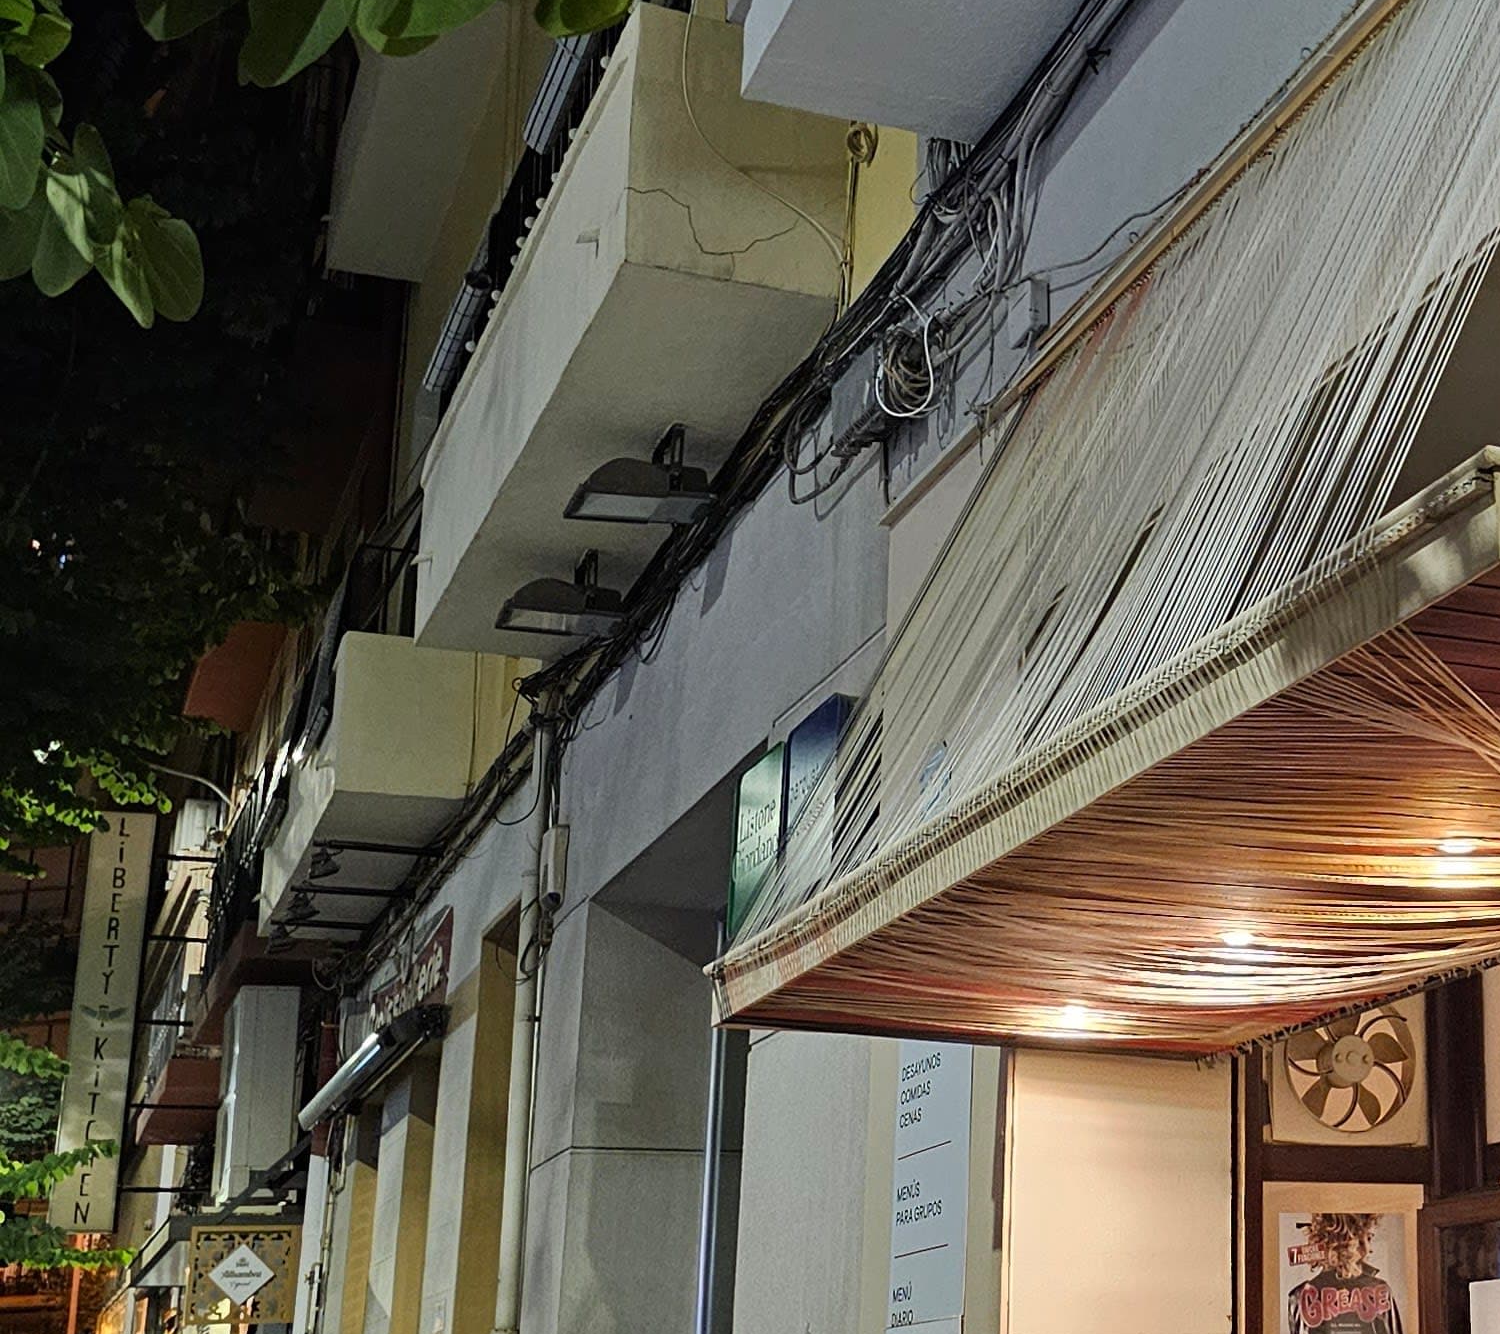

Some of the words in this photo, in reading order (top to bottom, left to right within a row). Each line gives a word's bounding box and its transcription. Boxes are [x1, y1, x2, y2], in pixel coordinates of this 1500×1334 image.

[901, 1052, 941, 1082] DESAYUNOS
[900, 1080, 931, 1106] COMIDAS
[73, 1036, 109, 1225] KITCEN
[899, 1107, 922, 1130] CENAS
[897, 1178, 921, 1203] MENÚS
[895, 1207, 914, 1227] PARA
[914, 1199, 942, 1222] GRUPOS
[892, 1281, 912, 1304] MENÚ
[891, 1309, 914, 1328] DIARIO
[1300, 1284, 1392, 1328] GREASE
